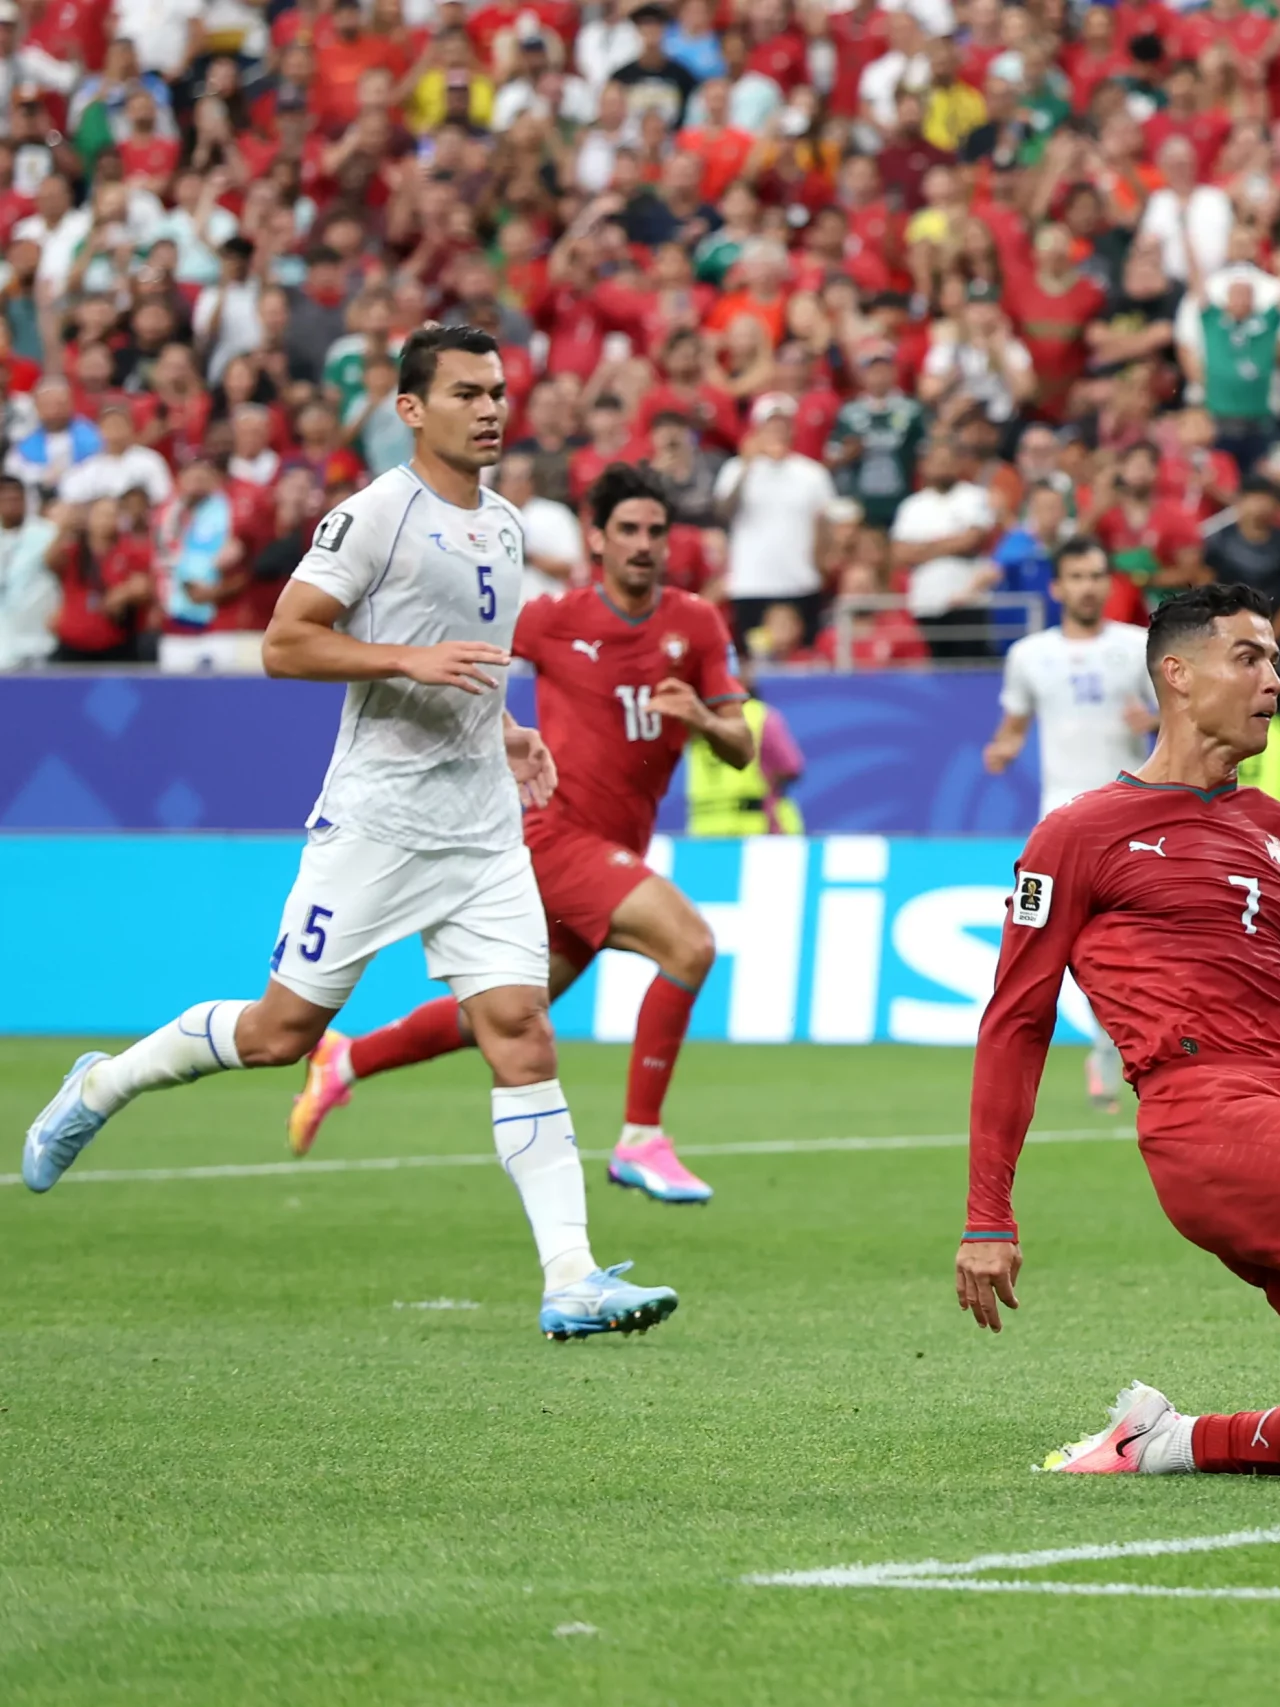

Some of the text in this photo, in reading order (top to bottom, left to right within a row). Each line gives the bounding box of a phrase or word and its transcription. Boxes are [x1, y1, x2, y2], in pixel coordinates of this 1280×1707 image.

[477, 566, 497, 622] 5
[299, 904, 335, 963] 5
[1227, 875, 1261, 936] 7
